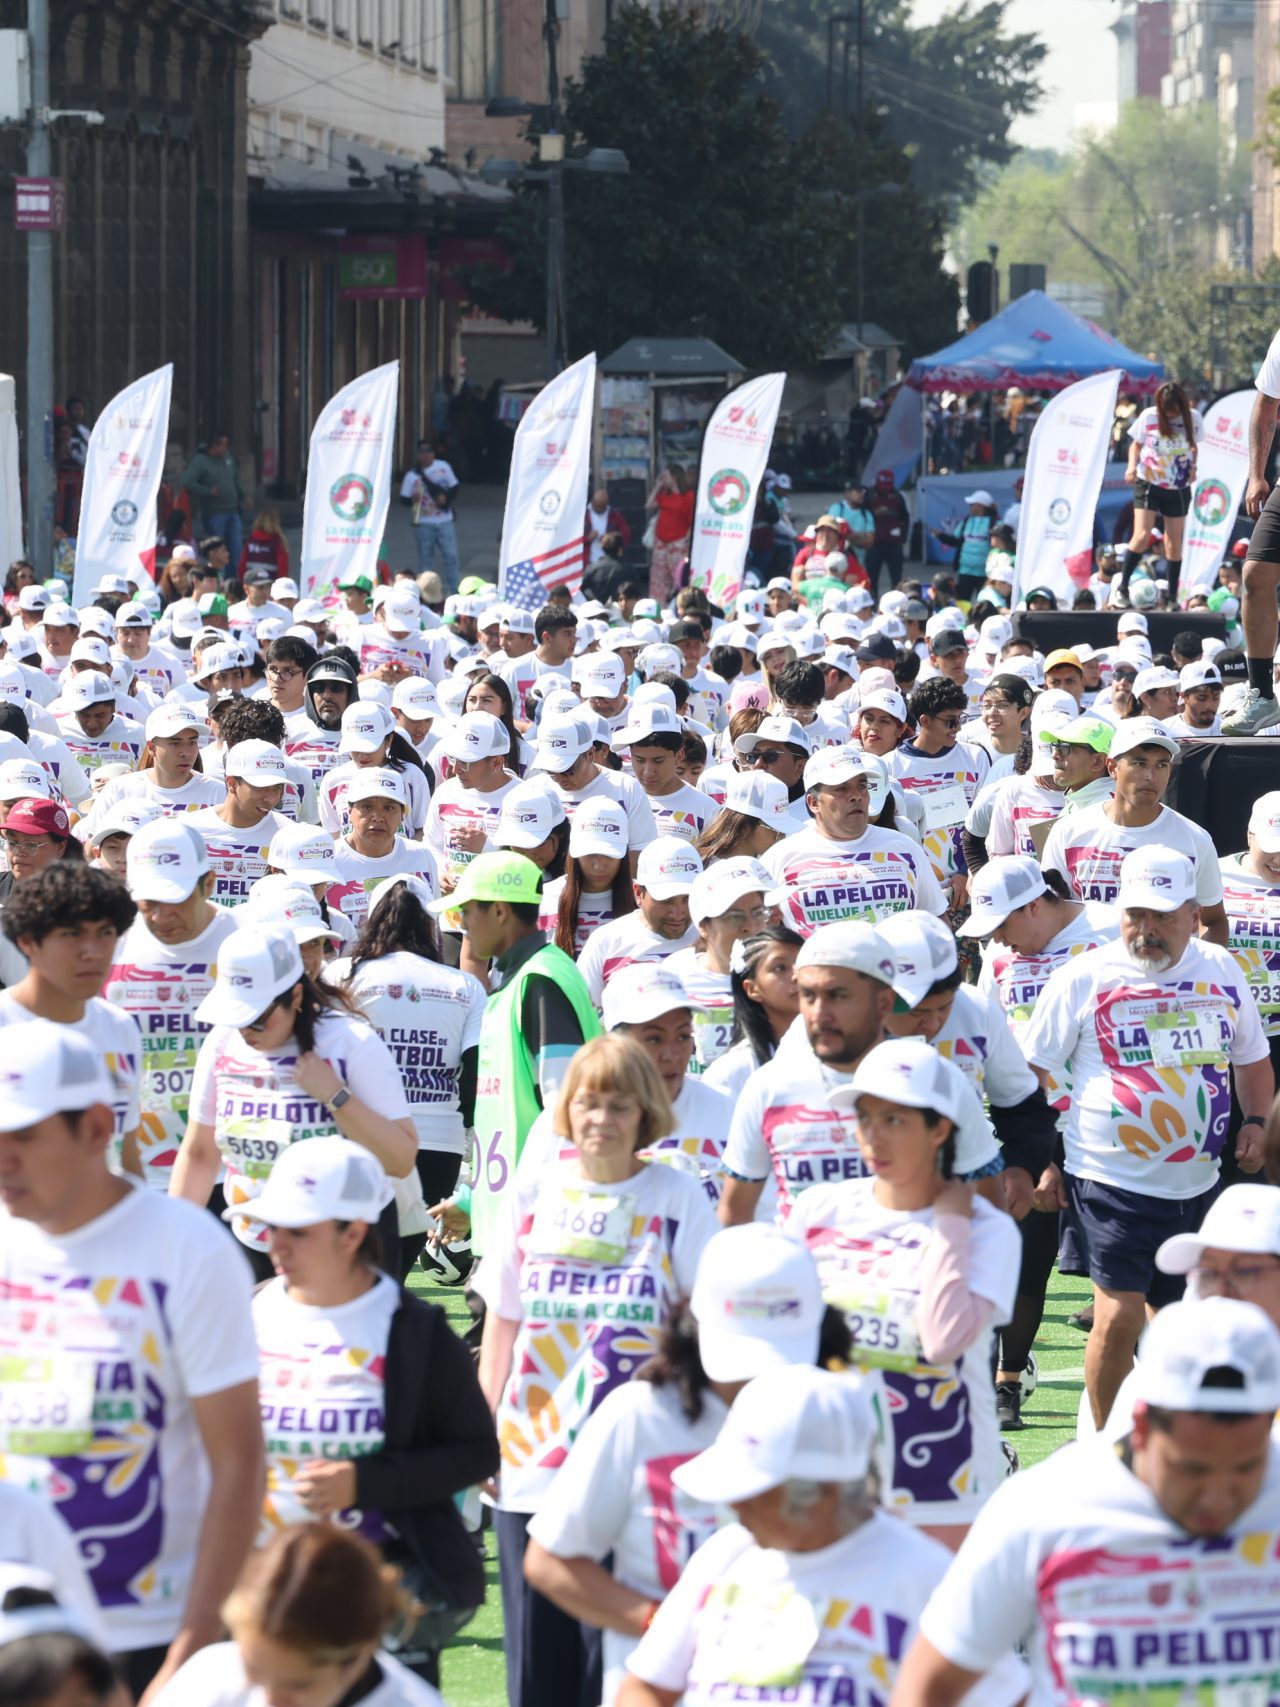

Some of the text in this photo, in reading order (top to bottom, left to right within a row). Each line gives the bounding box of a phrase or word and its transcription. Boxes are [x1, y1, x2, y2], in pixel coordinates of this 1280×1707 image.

[216, 879, 254, 896] PEL
[803, 883, 909, 907] LA PELOTA
[806, 907, 859, 922] VUELVE
[1227, 938, 1258, 949] ELVE
[1262, 941, 1271, 950] A
[1129, 1008, 1155, 1016] México
[150, 1014, 211, 1033] PELO
[142, 1037, 195, 1052] ELVE A
[391, 1028, 449, 1046] CLASE DE
[1117, 1027, 1150, 1049] LA
[1169, 1028, 1203, 1050] 211
[388, 1044, 446, 1067] TBOL
[241, 1101, 335, 1124] PELOTA
[226, 1136, 278, 1161] 5639
[784, 1158, 873, 1182] LA PEL
[553, 1207, 608, 1236] 468
[548, 1269, 657, 1298] PELOTA
[584, 1302, 598, 1319] A
[603, 1303, 655, 1323] CASA
[850, 1315, 900, 1349] 235
[260, 1405, 385, 1433] PELOTA
[1070, 1633, 1118, 1669] LA
